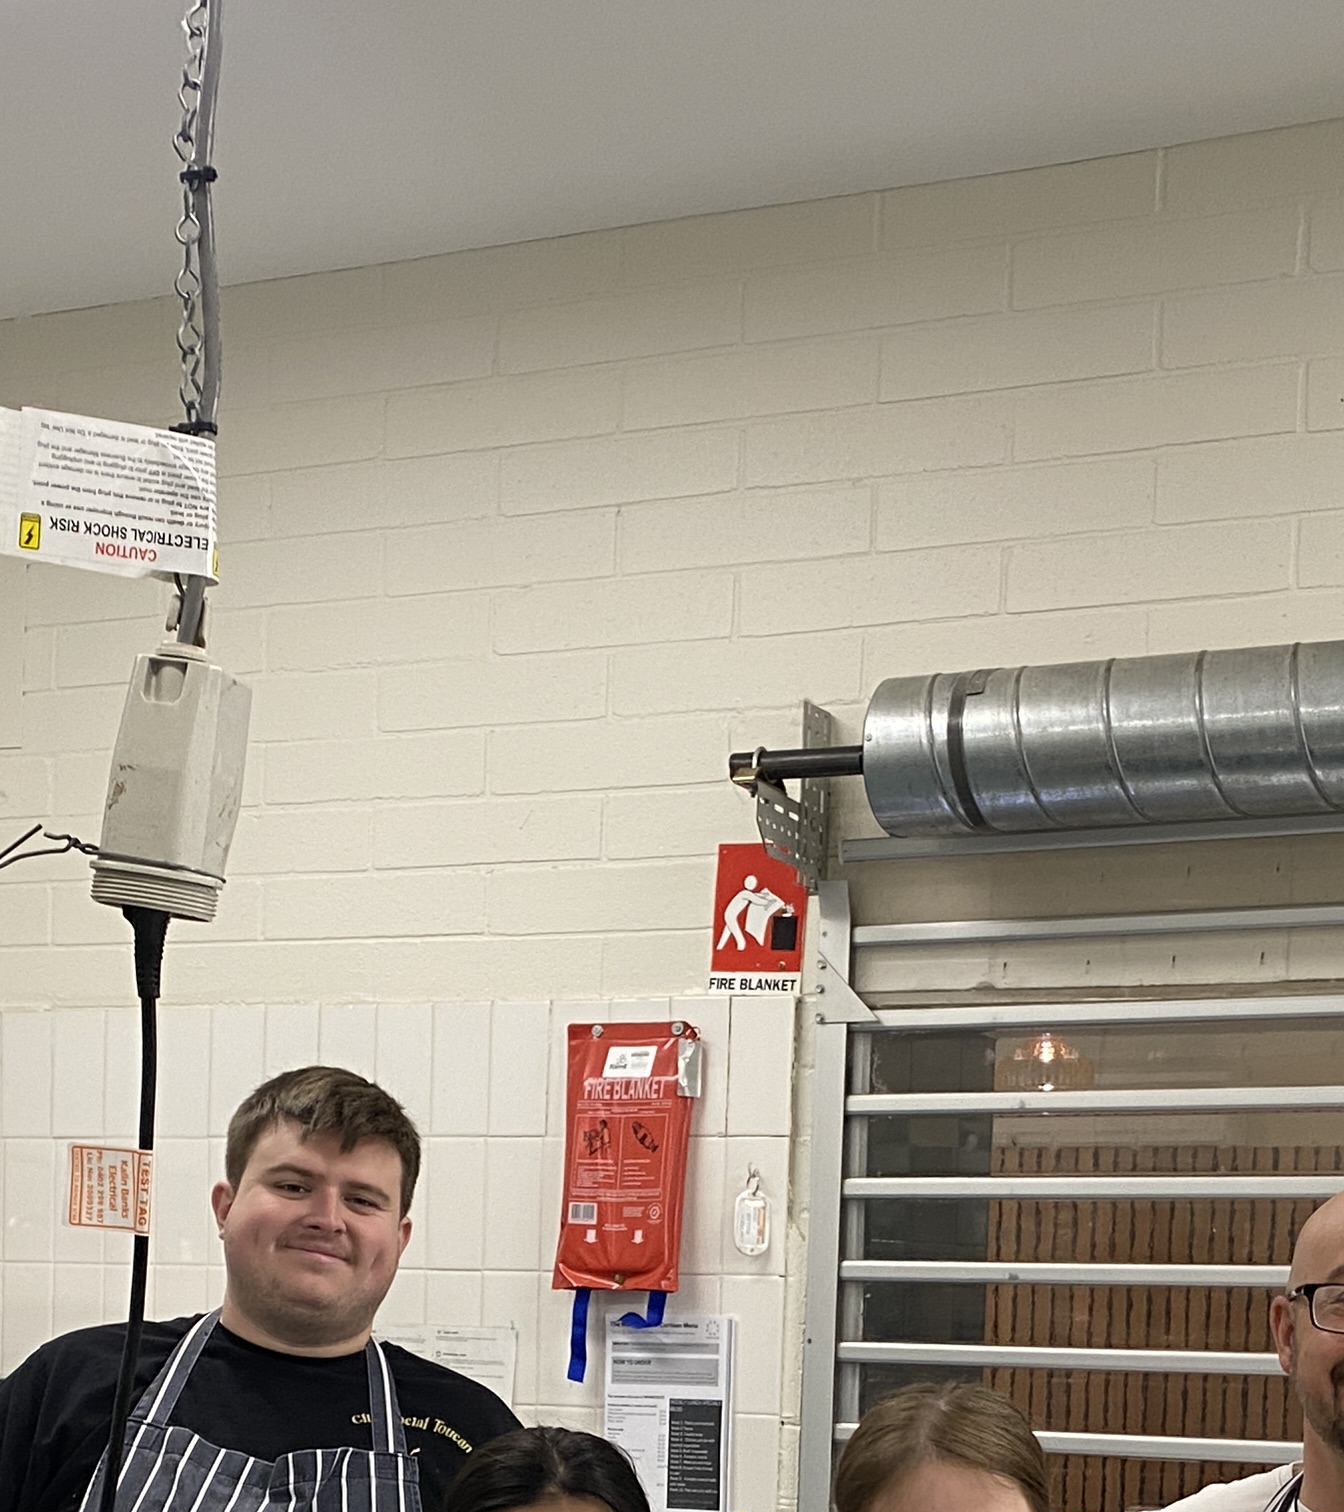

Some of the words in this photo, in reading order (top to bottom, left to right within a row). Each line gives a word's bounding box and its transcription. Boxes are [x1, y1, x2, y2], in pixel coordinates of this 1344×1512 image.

[50, 516, 79, 532] RISK
[84, 521, 127, 539] SHOCK
[131, 528, 208, 551] ELECTRICAL
[96, 542, 157, 562] CAUTION
[708, 977, 737, 992] FIRE
[739, 977, 798, 992] BLANKET
[583, 1078, 612, 1100] FIRE
[612, 1078, 665, 1100] BLANKET
[108, 1165, 117, 1212] Electrical
[140, 1161, 151, 1195] TEST
[138, 1199, 149, 1226] TAG
[433, 1418, 474, 1454] Toucan
